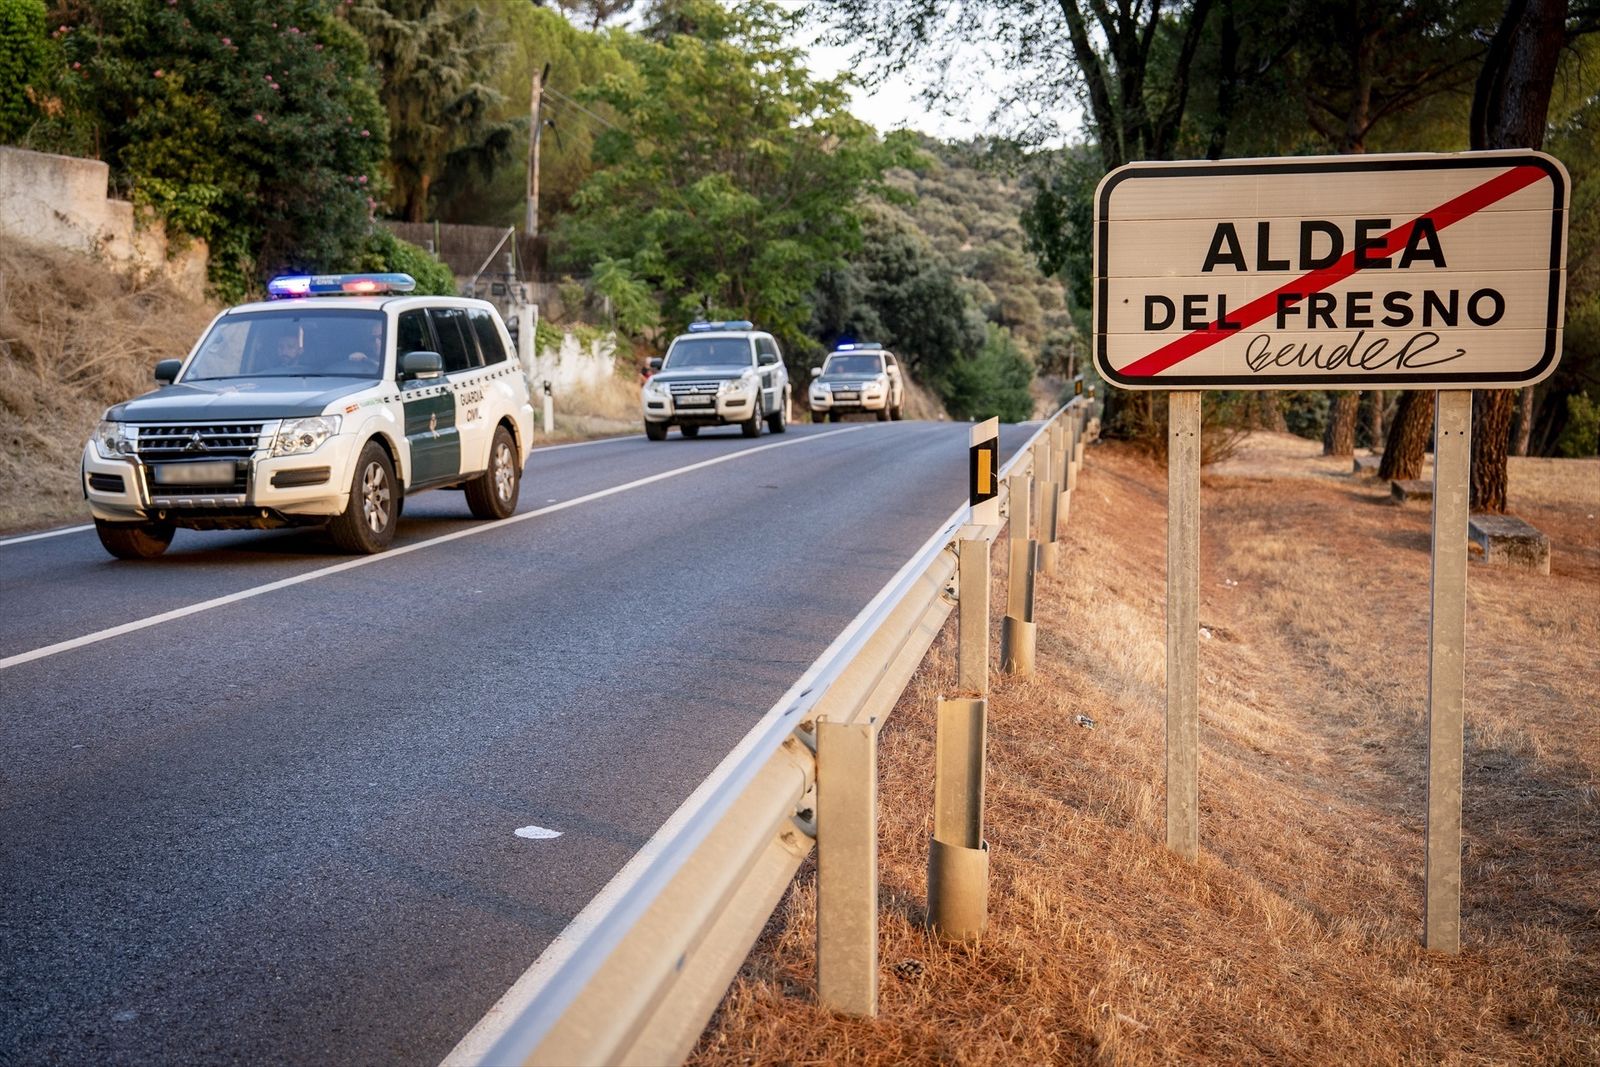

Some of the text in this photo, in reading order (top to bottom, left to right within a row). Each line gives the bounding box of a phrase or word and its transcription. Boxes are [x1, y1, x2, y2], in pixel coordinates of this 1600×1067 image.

[1201, 218, 1448, 272] ALDEA
[1144, 288, 1506, 331] DEL FRESNO
[460, 390, 484, 406] GUARDIA
[467, 408, 482, 422] CIVIL
